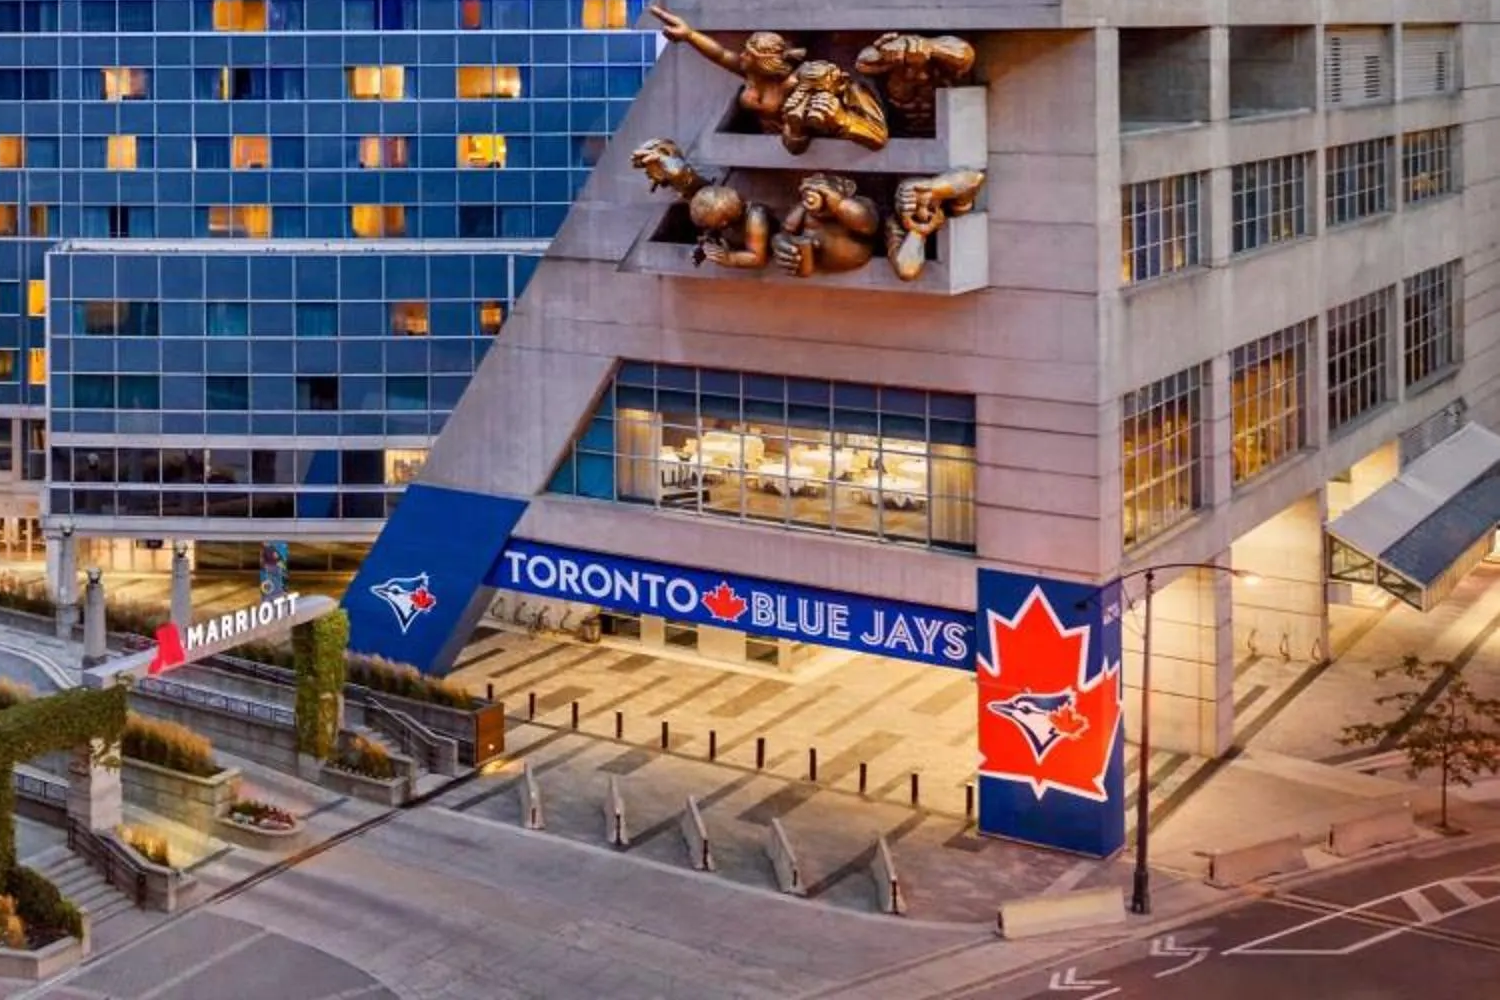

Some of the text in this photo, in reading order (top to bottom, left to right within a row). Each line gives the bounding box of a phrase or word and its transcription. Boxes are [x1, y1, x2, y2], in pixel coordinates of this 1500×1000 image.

[186, 592, 299, 650] MARRIOTT
[503, 549, 968, 660] TORONTO BLUE JAYS
